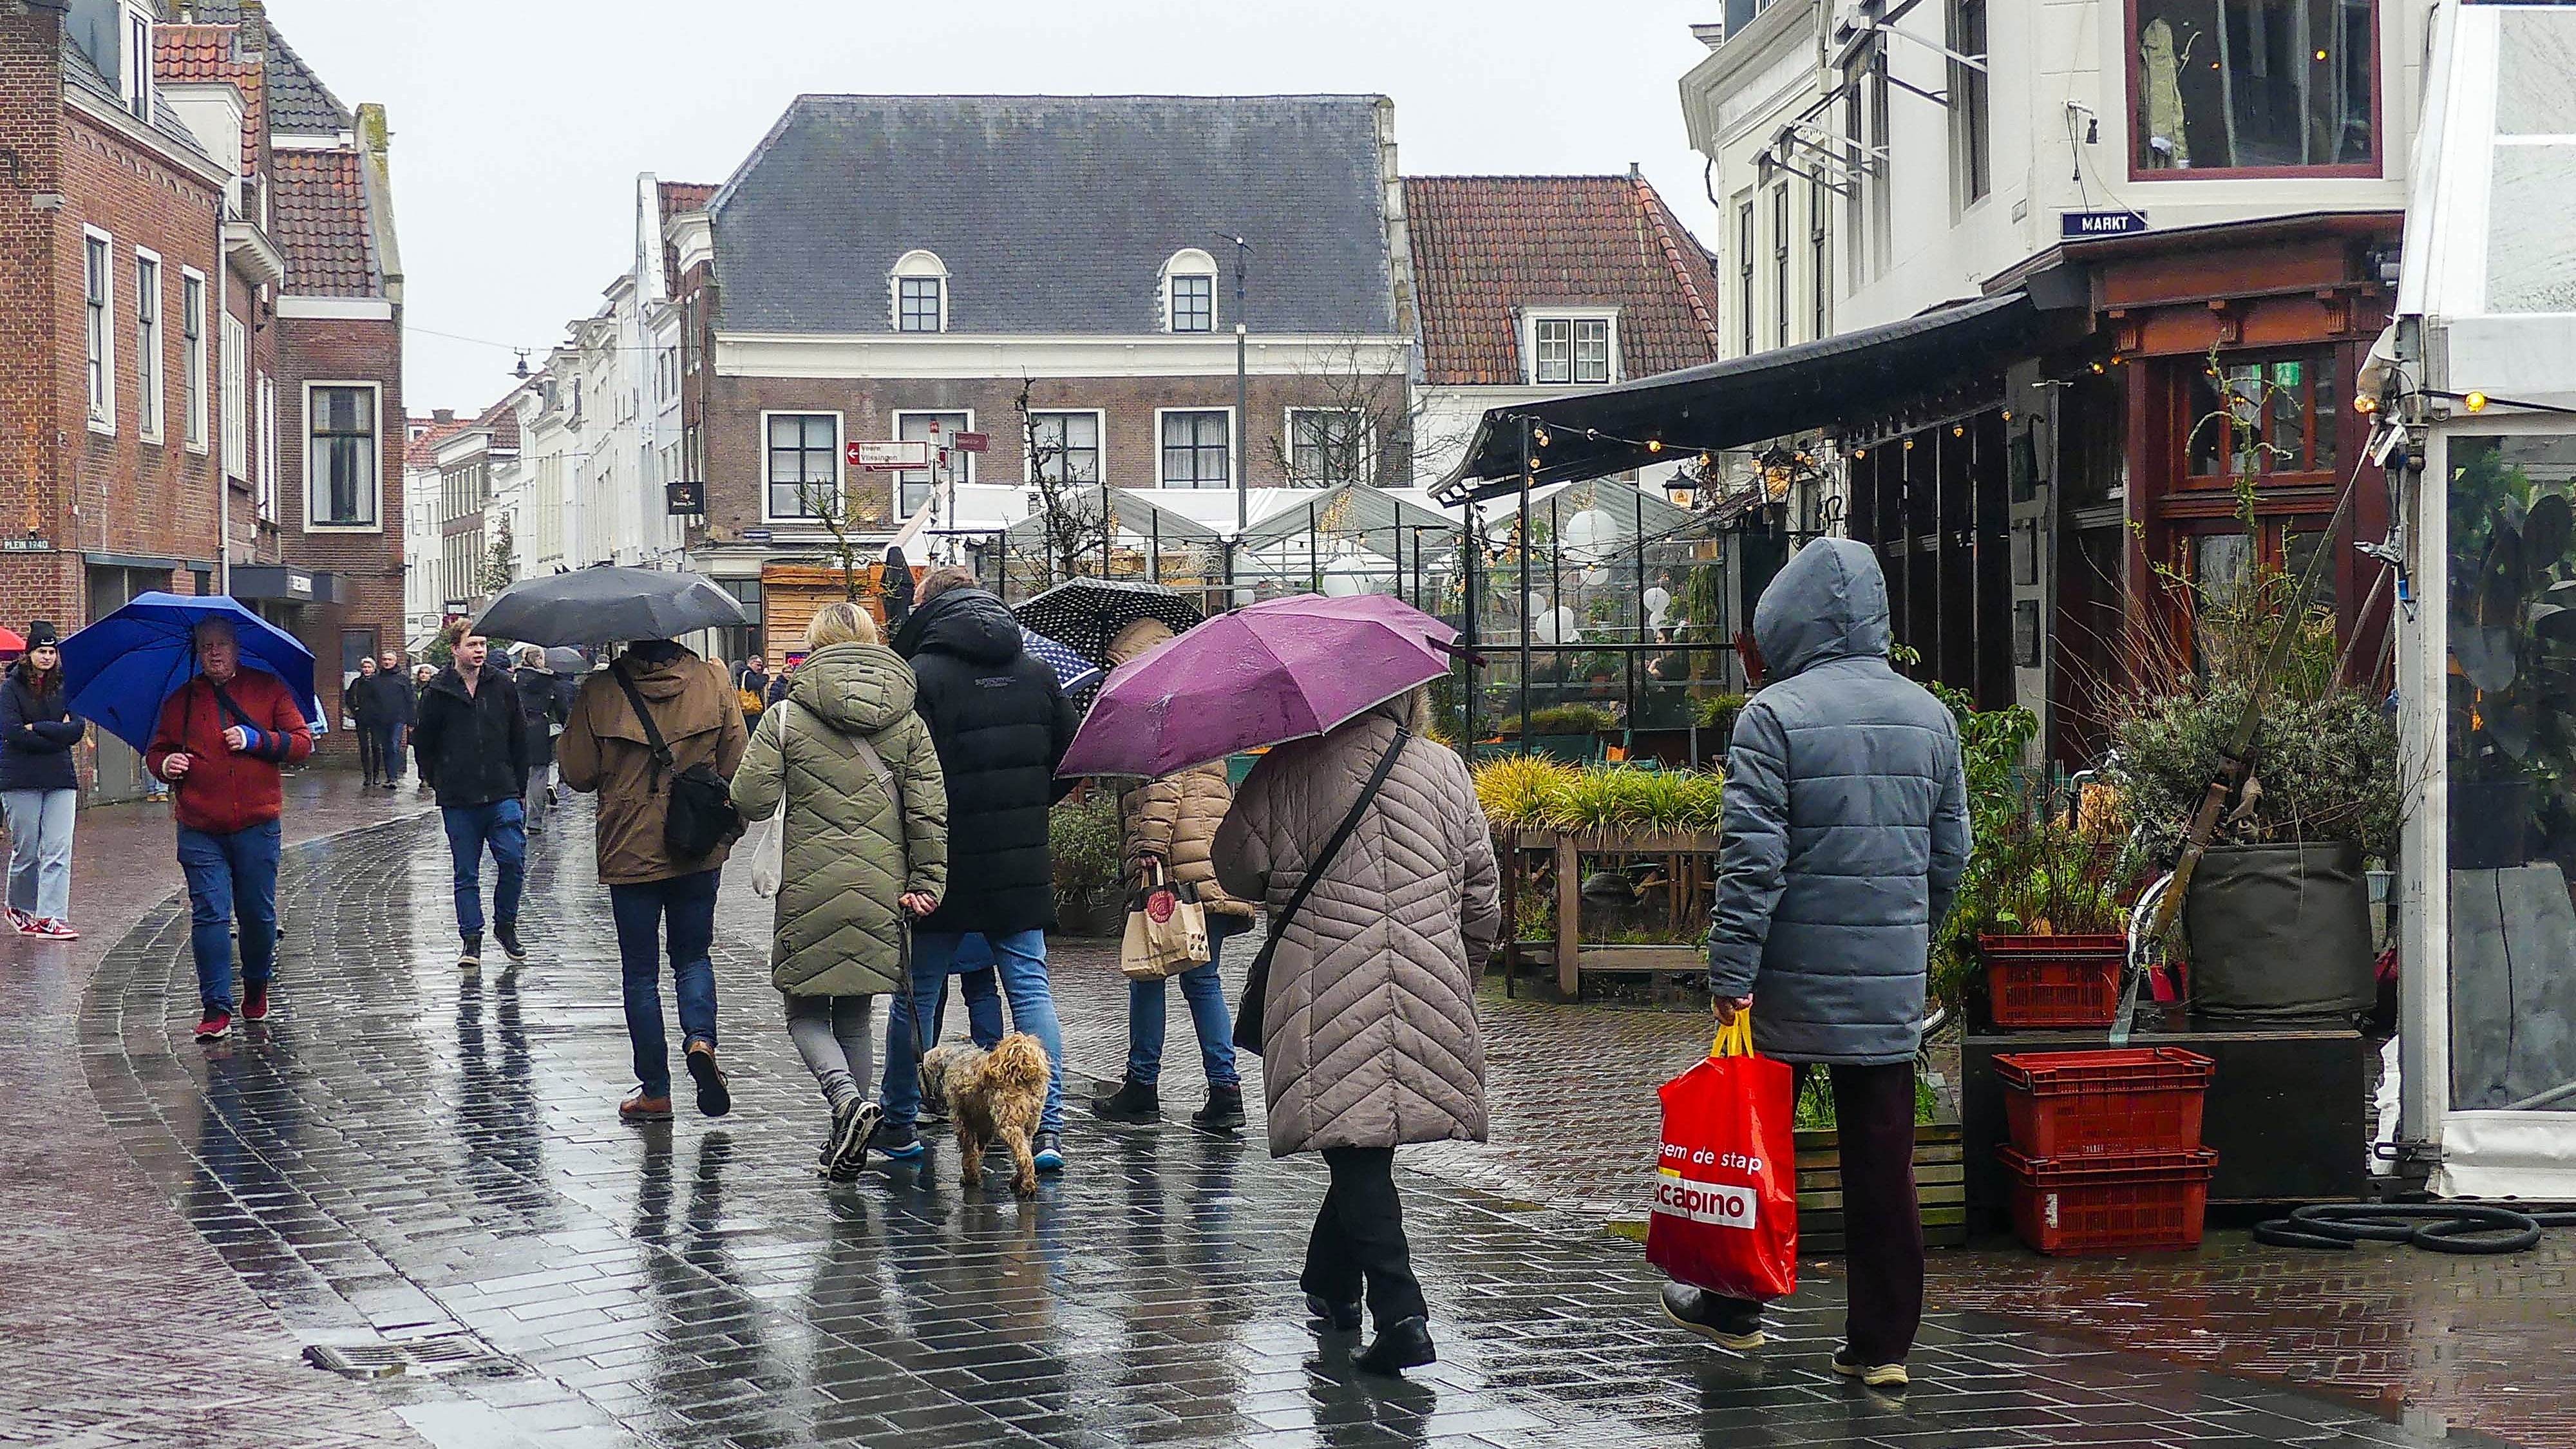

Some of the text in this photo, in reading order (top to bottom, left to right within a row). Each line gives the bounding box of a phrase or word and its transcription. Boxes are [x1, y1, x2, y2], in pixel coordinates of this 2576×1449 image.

[2082, 216, 2128, 231] MARKT
[5, 540, 48, 549] PLEIN 1940
[1693, 1146, 1714, 1164] de
[1721, 1151, 1763, 1175] stap
